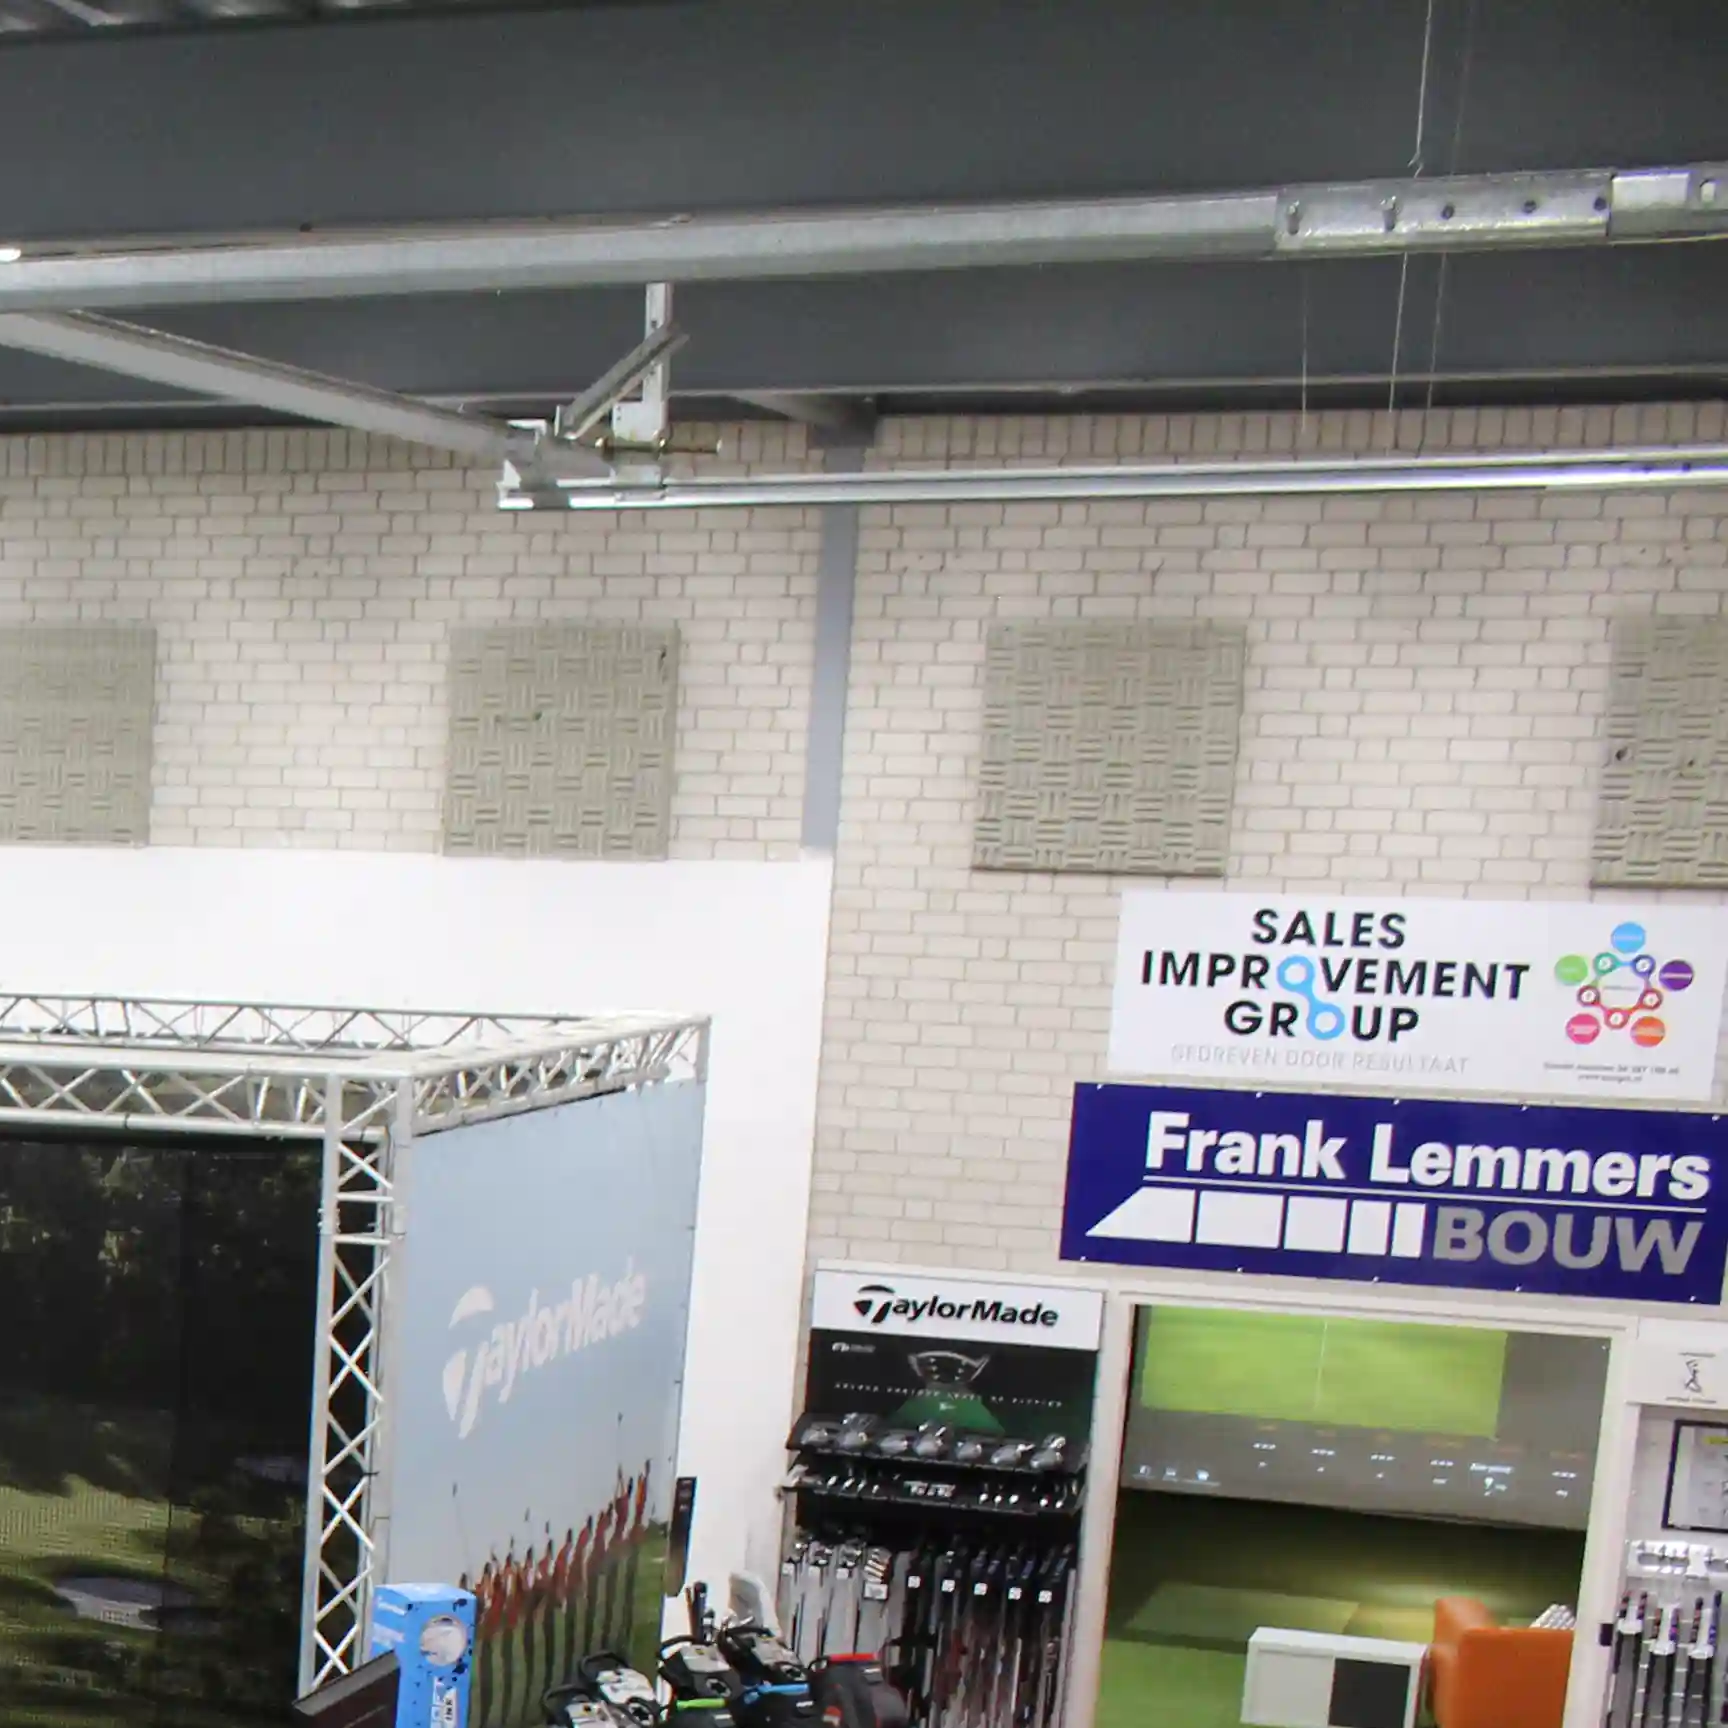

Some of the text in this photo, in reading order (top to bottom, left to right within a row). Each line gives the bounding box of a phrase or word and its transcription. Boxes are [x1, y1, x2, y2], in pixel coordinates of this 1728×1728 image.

[1253, 909, 1405, 949] SALES
[1142, 951, 1530, 1001] IMPROVEMENT
[1224, 1000, 1419, 1043] GROUP
[1170, 1042, 1470, 1075] GEDREVEN DOOR RESULTAAT
[1145, 1111, 1710, 1200] Frank Lemmers
[1432, 1206, 1704, 1275] BOUW
[853, 1284, 1059, 1327] TaylorMade
[442, 1255, 647, 1440] TaylorMade
